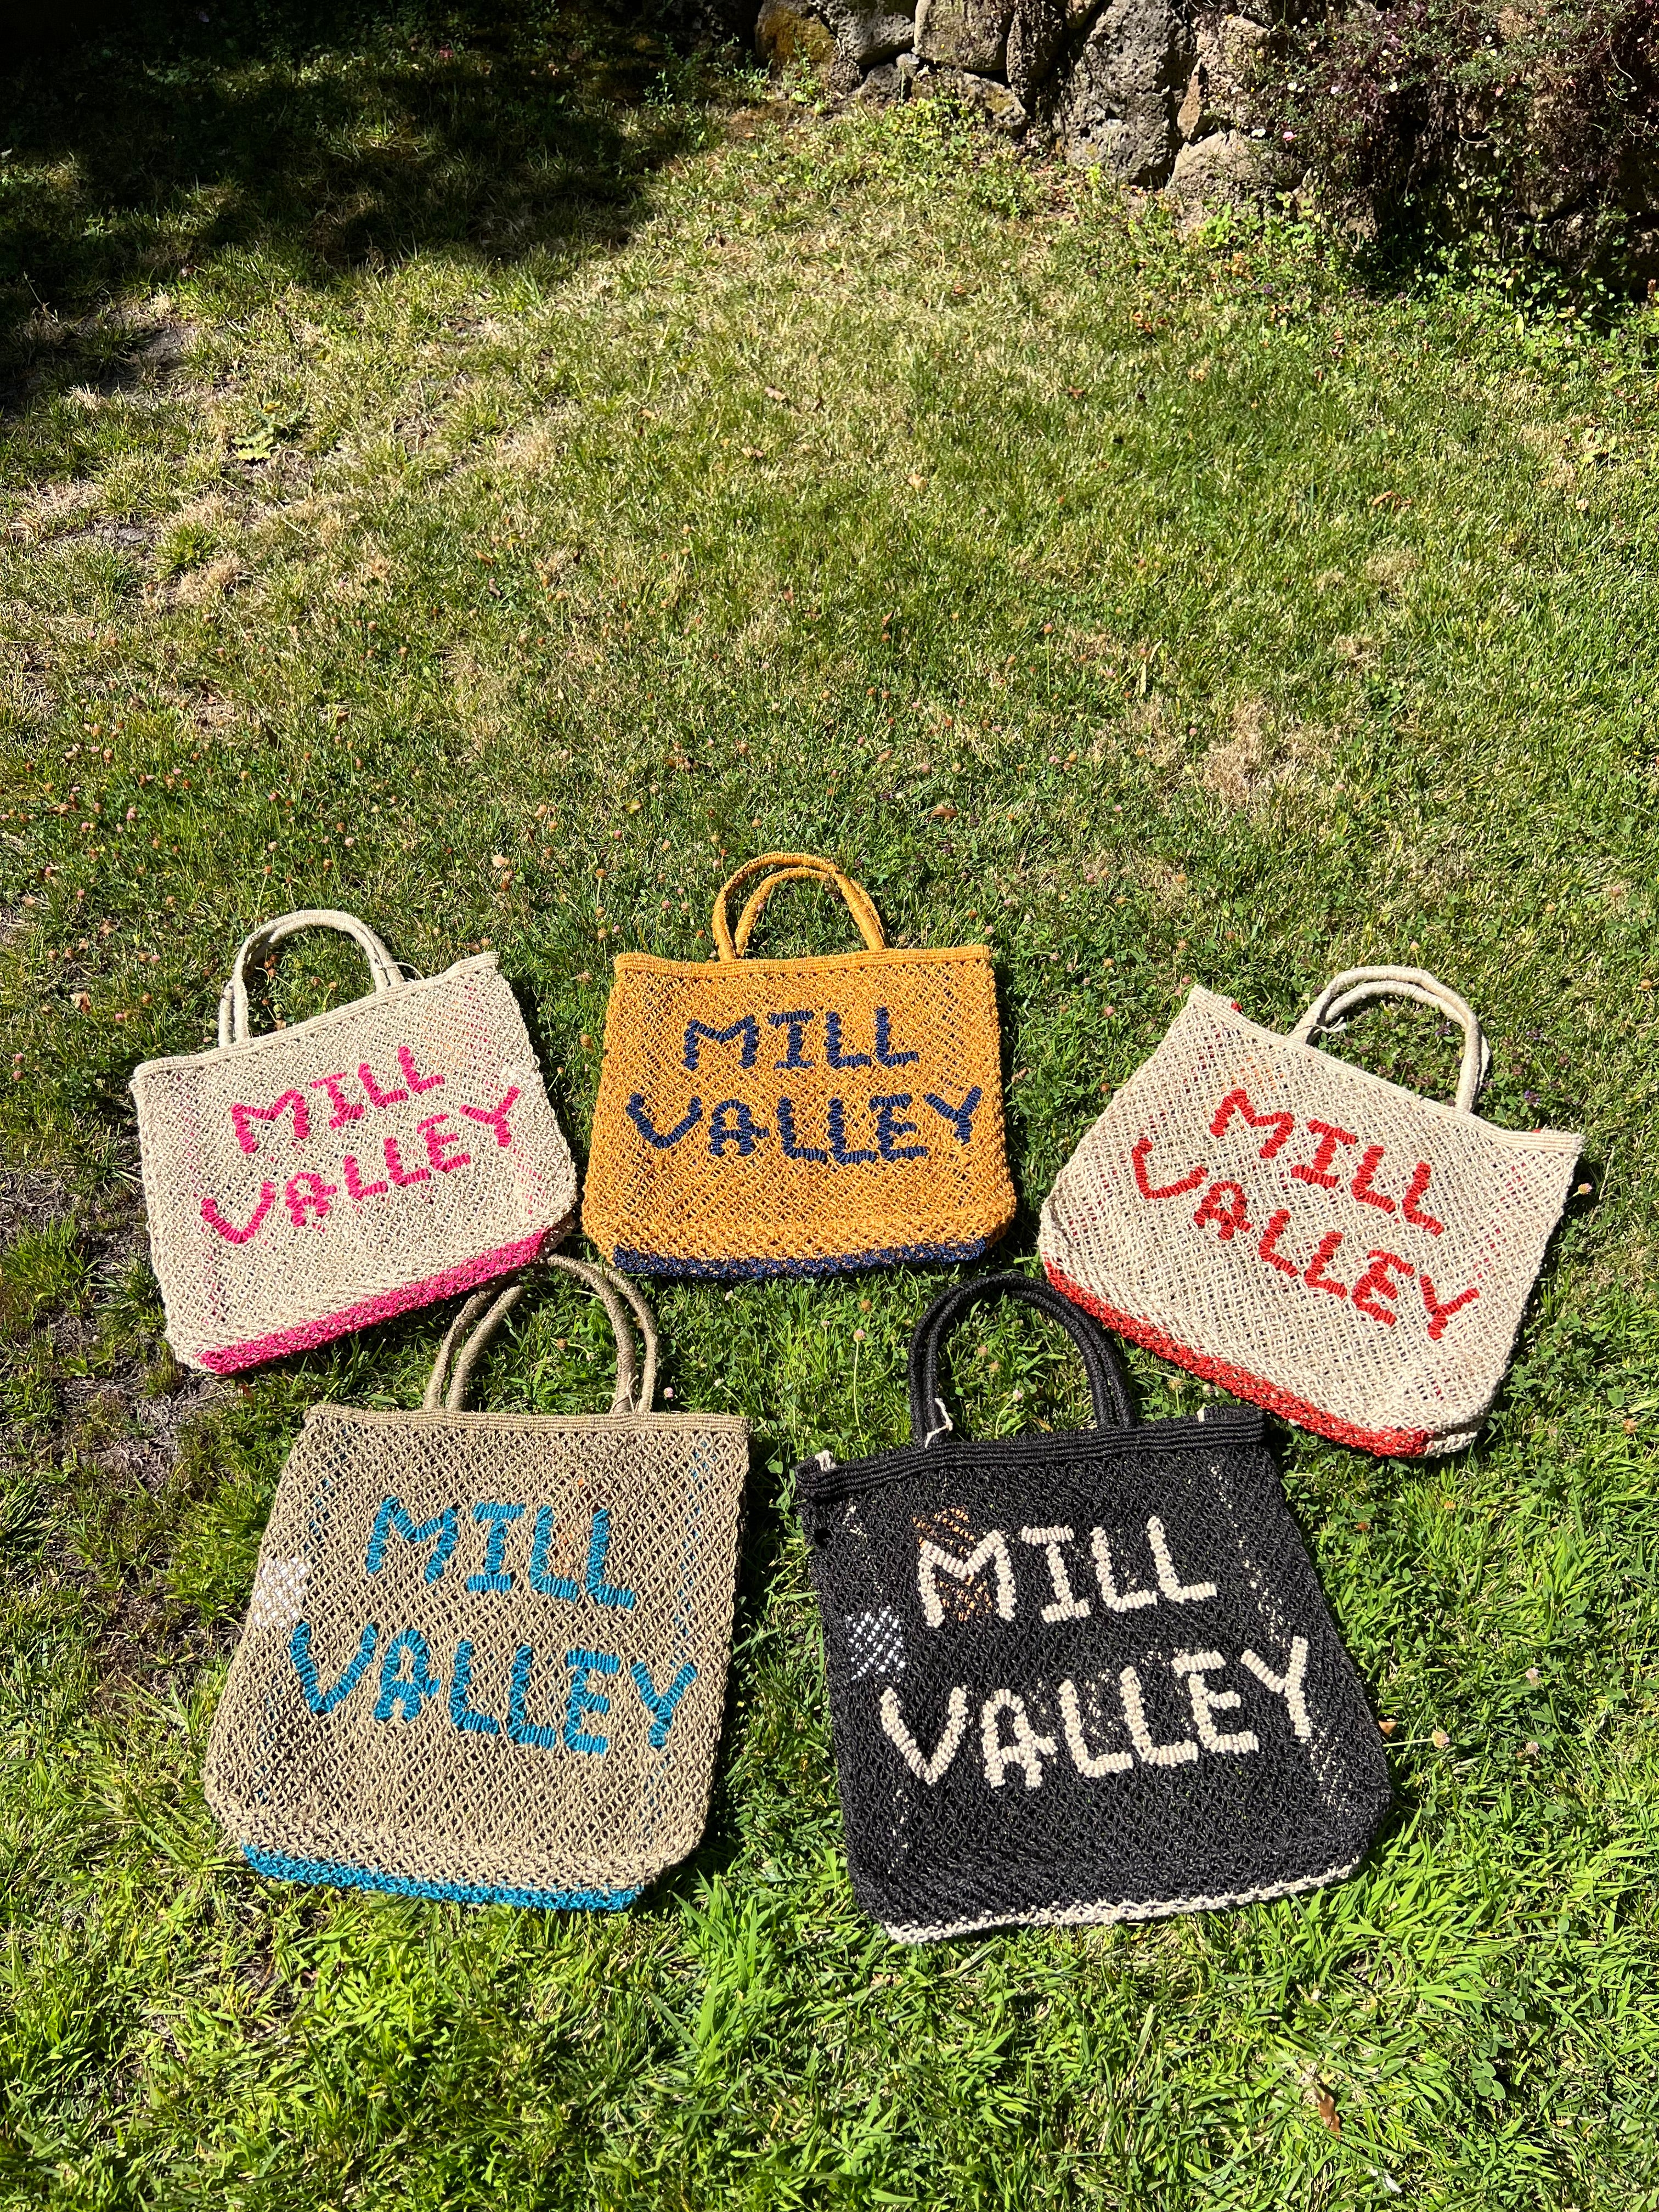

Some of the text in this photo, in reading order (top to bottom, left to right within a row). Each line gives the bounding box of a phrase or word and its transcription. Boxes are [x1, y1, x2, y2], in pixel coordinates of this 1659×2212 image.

[232, 1046, 444, 1154] MILL
[683, 1006, 919, 1071] MILL
[201, 1086, 520, 1244] VALLEY
[626, 1086, 981, 1165] VALLEY
[1210, 1088, 1443, 1235] MILL
[1132, 1137, 1479, 1340] VALLEY
[365, 1497, 636, 1610] MILL
[917, 1516, 1217, 1627] MILL
[289, 1621, 698, 1755] VALLEY
[880, 1637, 1308, 1787] VALLEY
